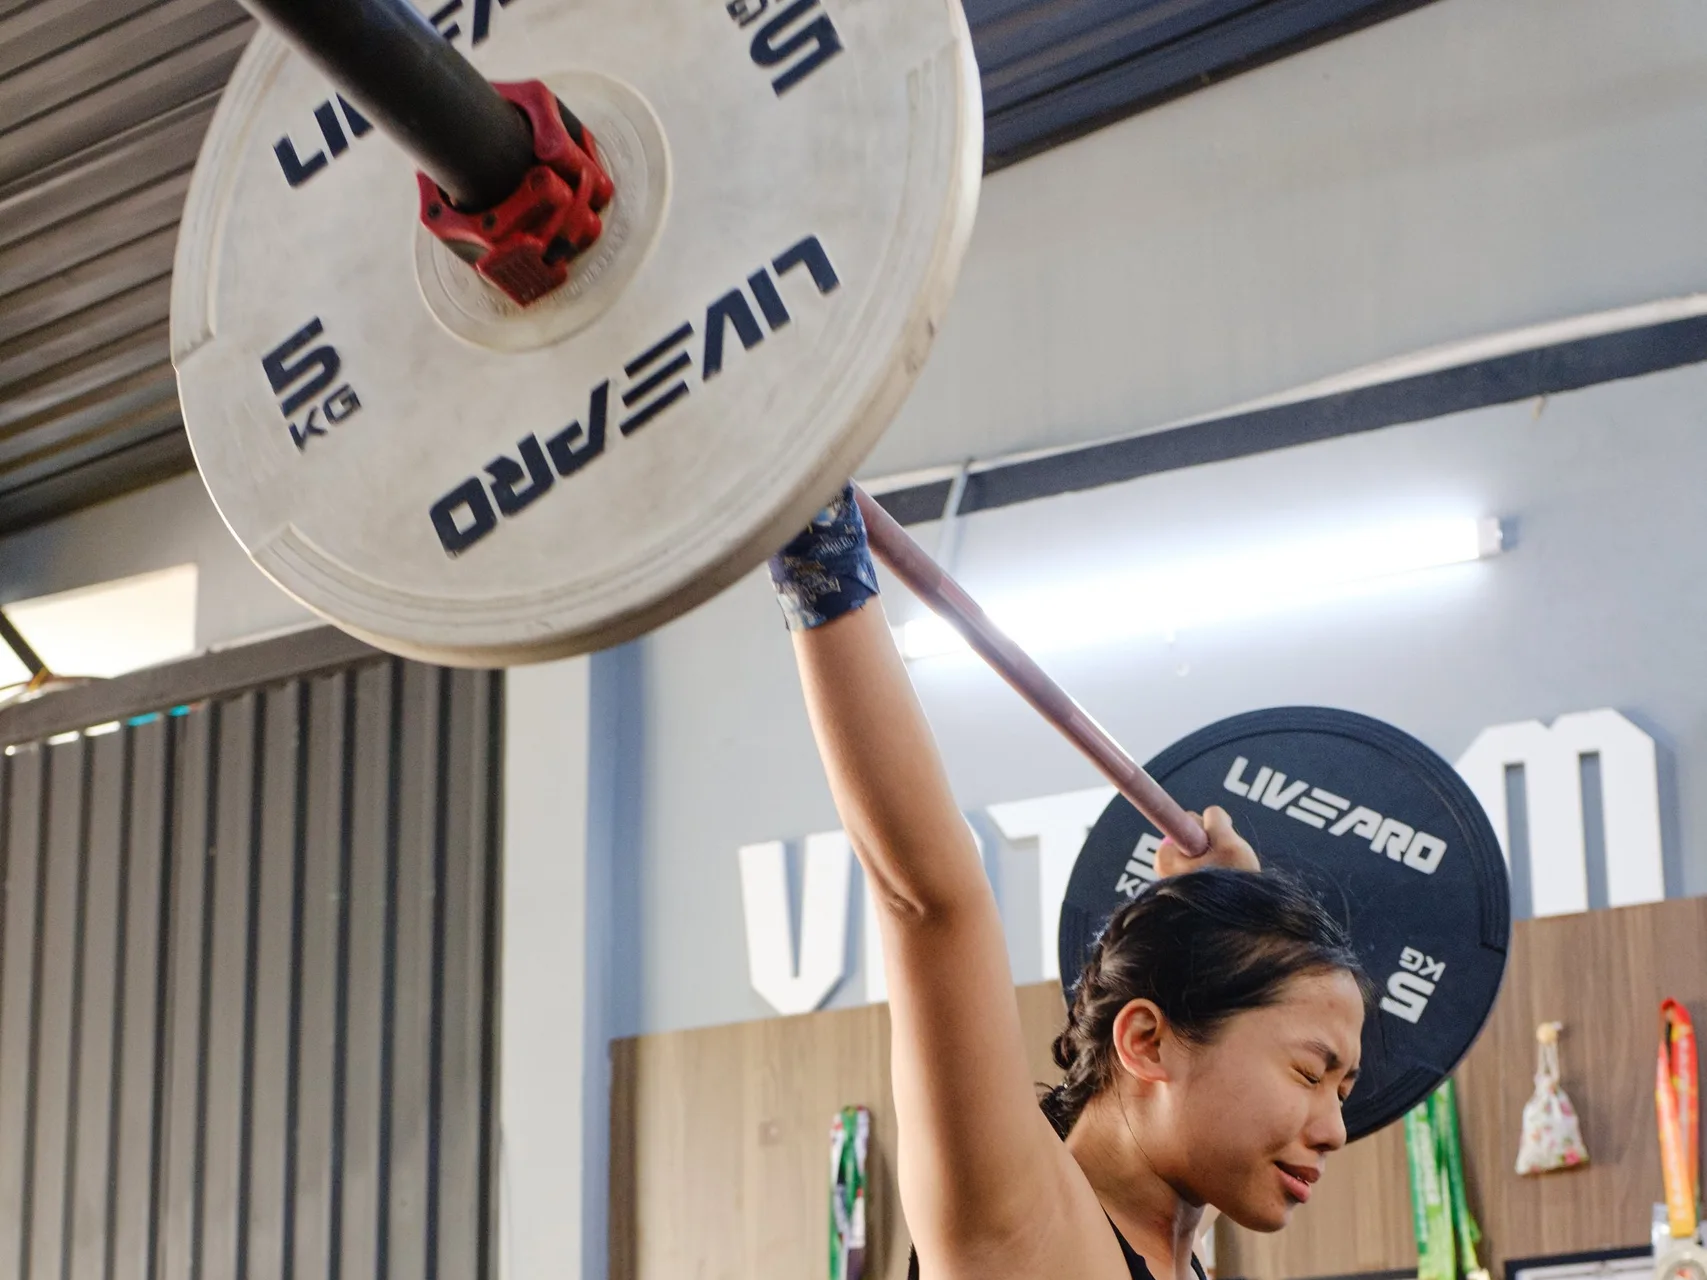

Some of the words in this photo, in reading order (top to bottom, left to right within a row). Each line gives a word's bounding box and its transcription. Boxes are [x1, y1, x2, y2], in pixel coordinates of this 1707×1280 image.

[750, 0, 844, 98] 5
[262, 316, 341, 419] 5
[430, 234, 840, 559] LIVEPRO
[288, 384, 362, 454] KG
[1223, 755, 1444, 875] LIVEPRO
[1380, 971, 1436, 1024] 5
[1398, 946, 1446, 982] KG
